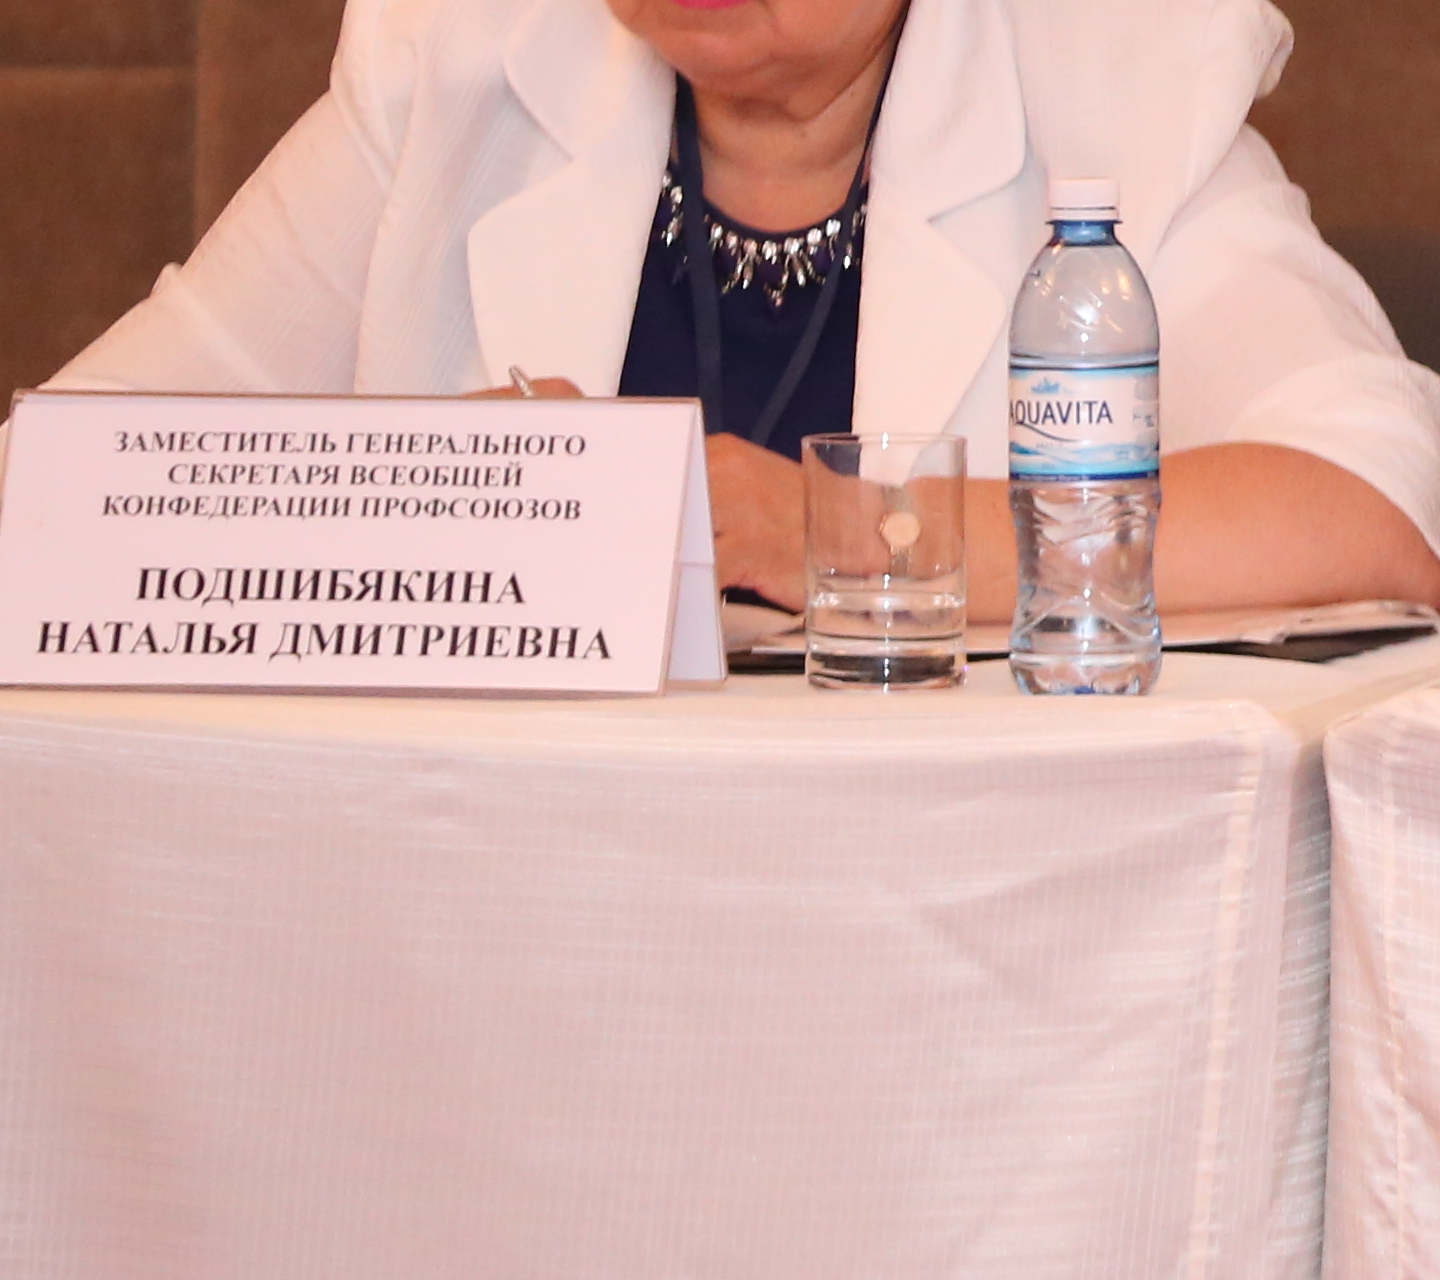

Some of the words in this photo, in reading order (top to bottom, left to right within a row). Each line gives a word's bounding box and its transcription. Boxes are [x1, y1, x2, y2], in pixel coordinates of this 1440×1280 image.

[116, 431, 336, 453] ЗАМЕСТИТЕЛЬ
[347, 433, 585, 456] ГЕНЕРАЛЬНОГО
[168, 463, 339, 485] СЕКРЕТАРЯ
[350, 463, 522, 489] ВСЕОБЩЕЙ
[102, 495, 350, 519] КОНФЕДЕРАЦИИ
[361, 497, 581, 520] ПРОФСОЮЗОВ
[137, 568, 524, 605] ПОДШИБЯКИНА
[38, 621, 258, 654] НАТАЛЬЯ
[269, 624, 610, 661] ДМИТРИЕВНА
